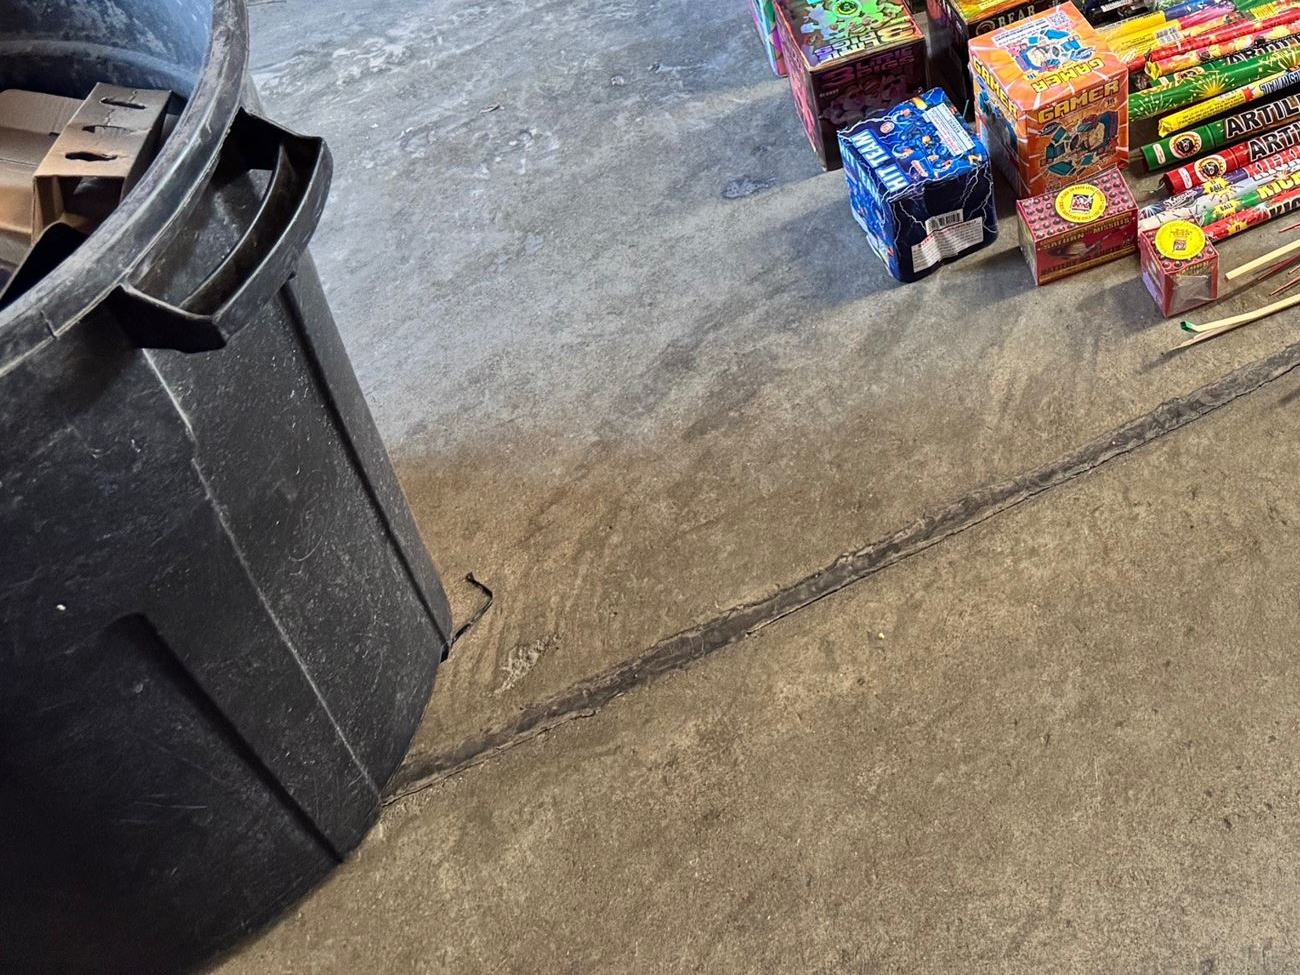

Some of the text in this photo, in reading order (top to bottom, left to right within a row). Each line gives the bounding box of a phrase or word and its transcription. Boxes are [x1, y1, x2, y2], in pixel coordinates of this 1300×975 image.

[972, 57, 1019, 121] GAMER
[1030, 57, 1105, 93] GAMER
[1259, 77, 1281, 94] TAIL
[1038, 78, 1121, 125] GAMER
[851, 129, 909, 193] HIT TEAM
